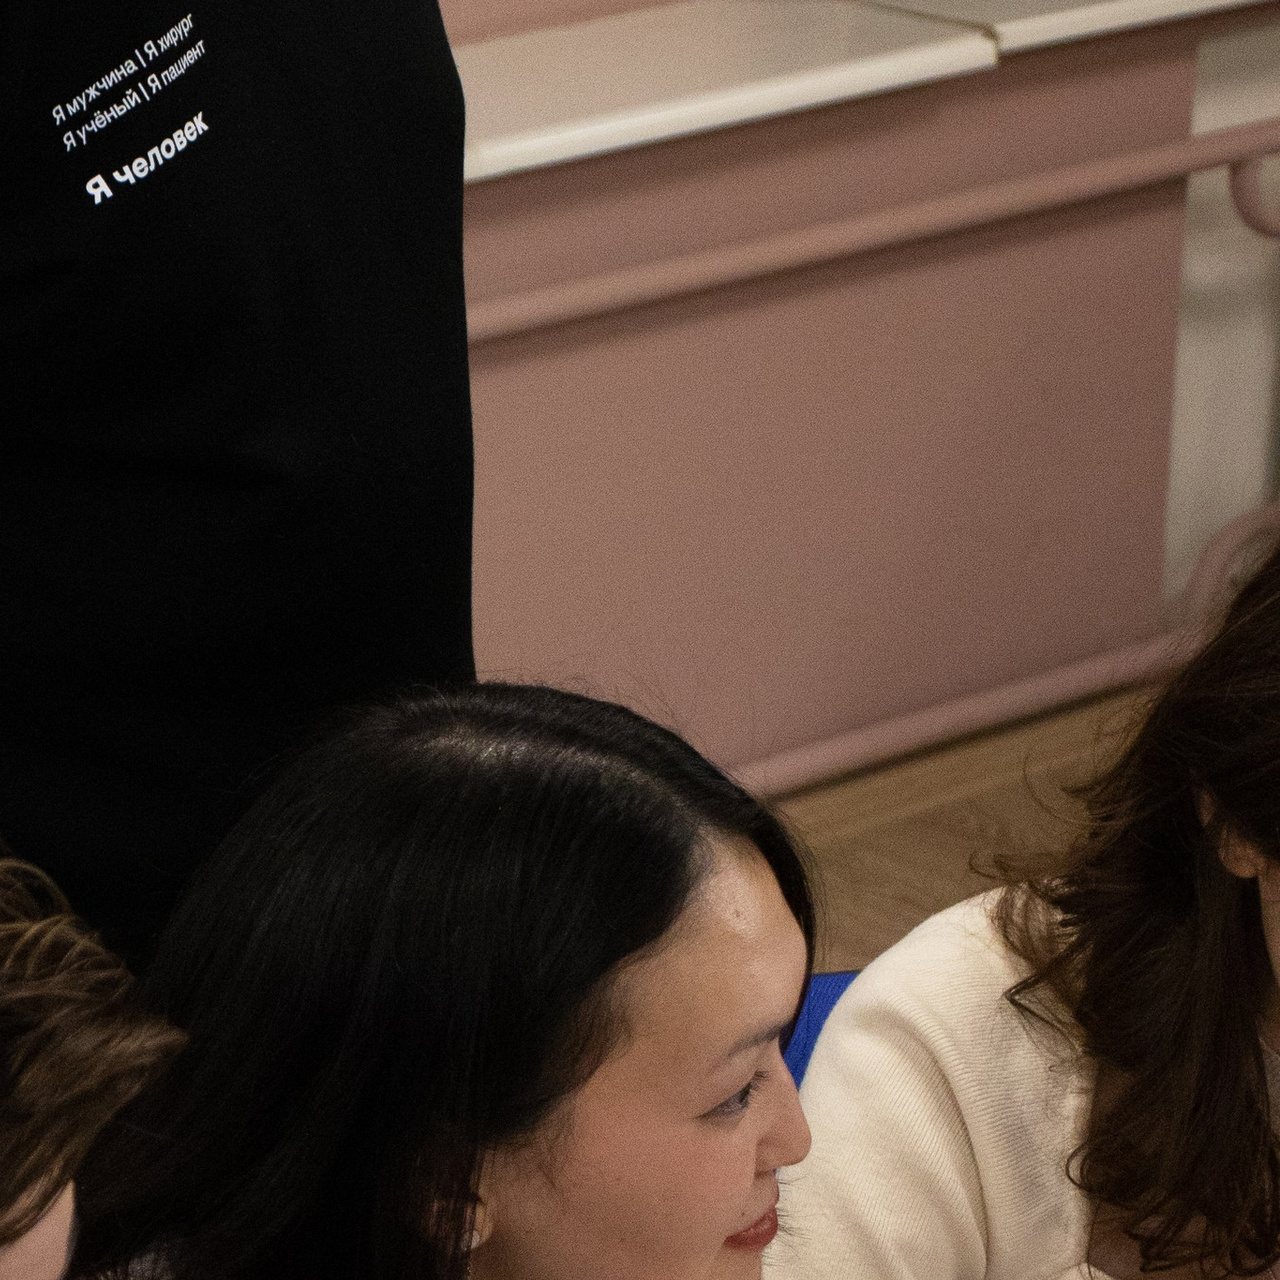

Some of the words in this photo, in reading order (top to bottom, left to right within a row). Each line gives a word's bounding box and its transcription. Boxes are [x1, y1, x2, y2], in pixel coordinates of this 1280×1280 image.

[51, 104, 67, 126] Я
[65, 59, 139, 116] мужчина
[143, 39, 159, 61] Я
[156, 13, 194, 53] хирург
[62, 130, 77, 152] Я
[76, 88, 142, 145] учёный
[146, 73, 163, 95] Я
[160, 39, 206, 86] пациент
[85, 173, 114, 205] Я
[112, 111, 210, 185] человек
